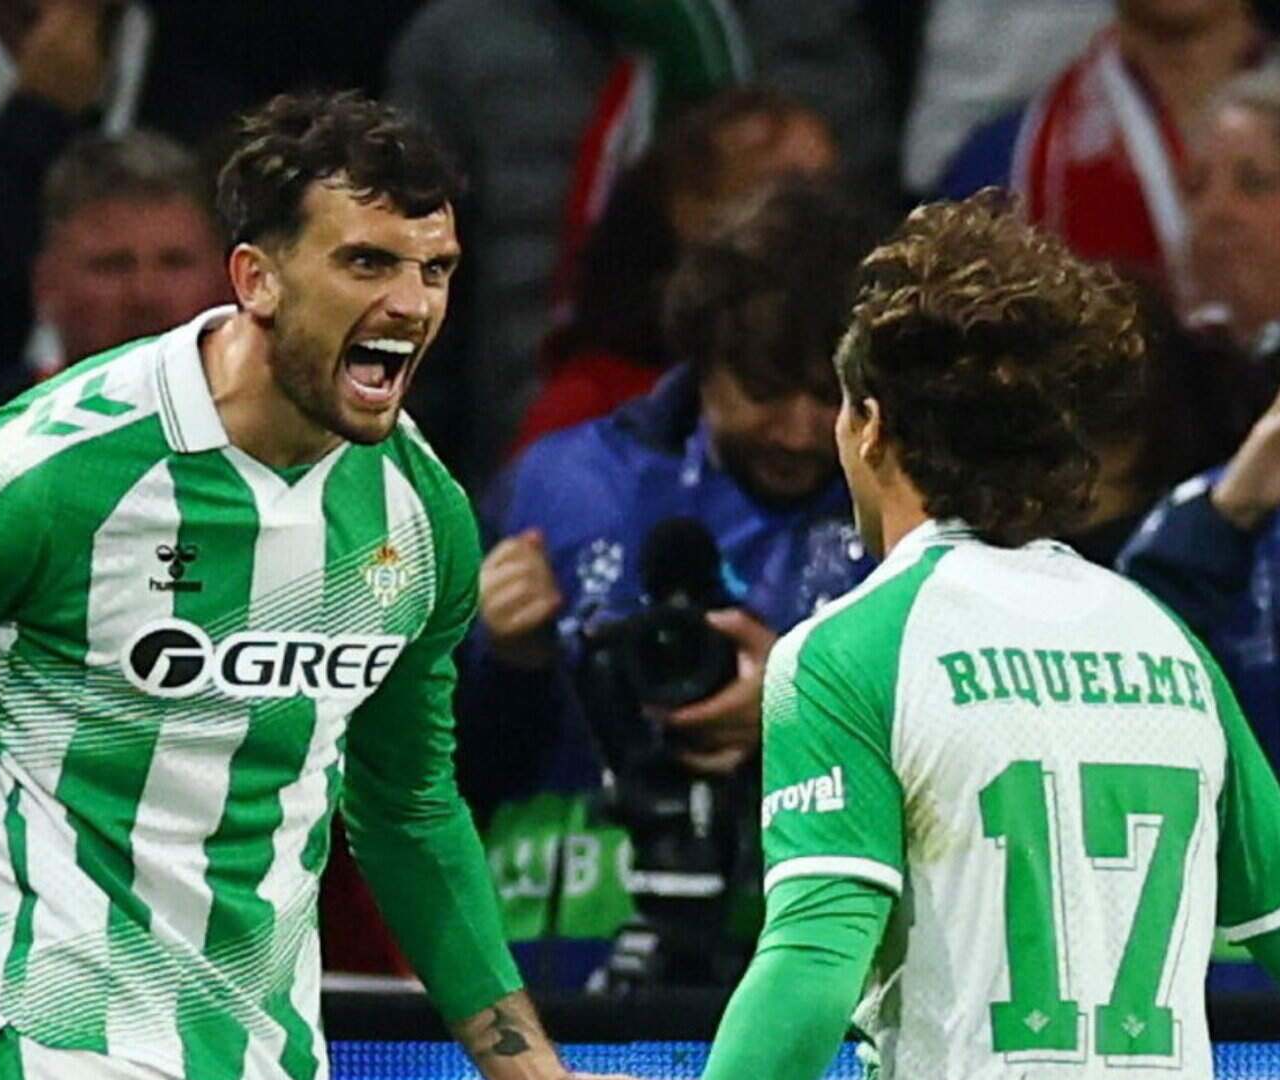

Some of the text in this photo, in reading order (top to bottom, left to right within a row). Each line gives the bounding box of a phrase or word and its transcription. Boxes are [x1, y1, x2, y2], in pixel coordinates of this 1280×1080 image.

[221, 641, 398, 689] GREE
[936, 646, 1207, 713] RIQUELME
[979, 759, 1205, 1068] 17
